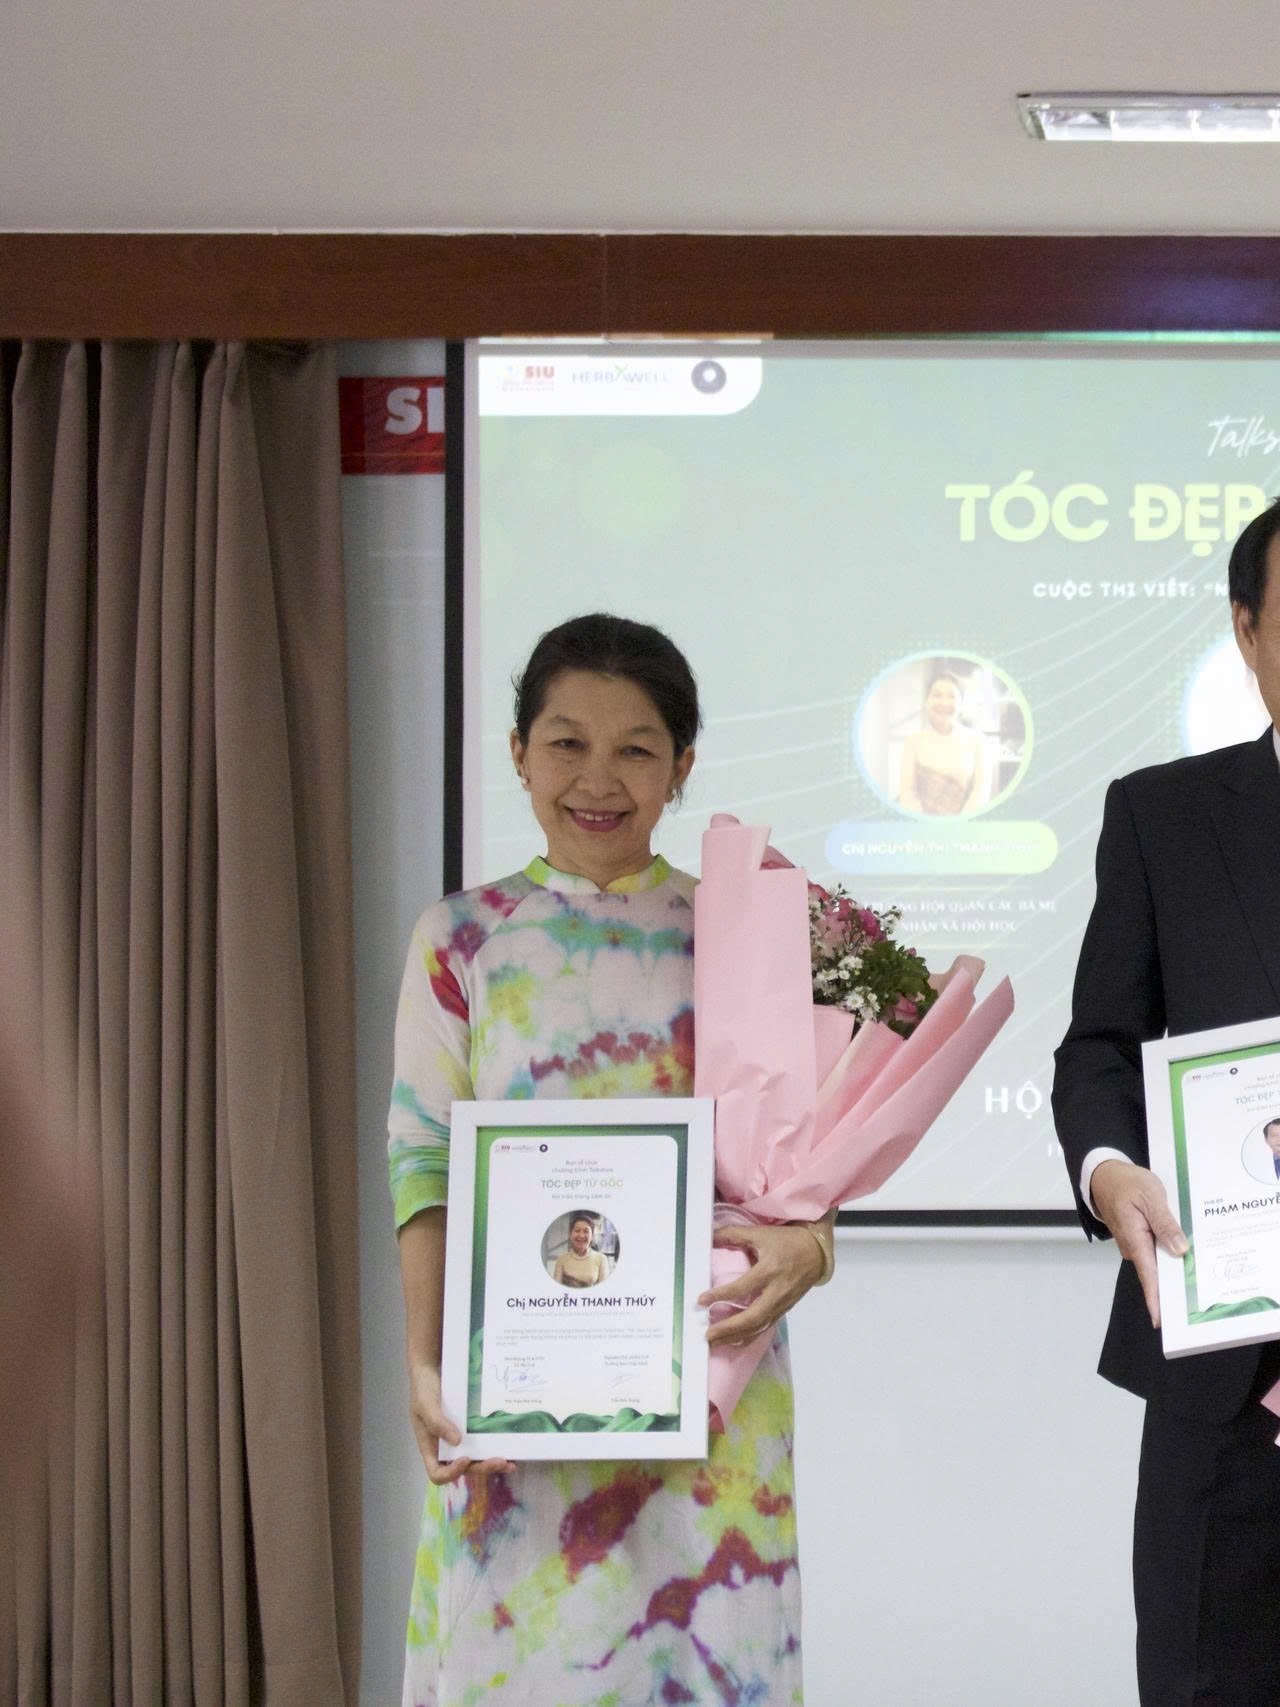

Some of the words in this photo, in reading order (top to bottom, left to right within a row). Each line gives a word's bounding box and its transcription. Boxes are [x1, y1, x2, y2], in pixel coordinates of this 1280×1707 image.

[525, 366, 555, 378] SIU
[384, 386, 445, 436] SI
[945, 470, 1109, 542] TÓC
[1128, 483, 1266, 557] ĐẸP
[1033, 580, 1093, 600] CUỘC
[1100, 582, 1136, 598] THI
[1204, 1203, 1239, 1217] PHẠM
[506, 1297, 526, 1310] Chị
[529, 1293, 578, 1308] NGUYỄN
[581, 1297, 621, 1307] THANH
[624, 1294, 656, 1307] THÚY
